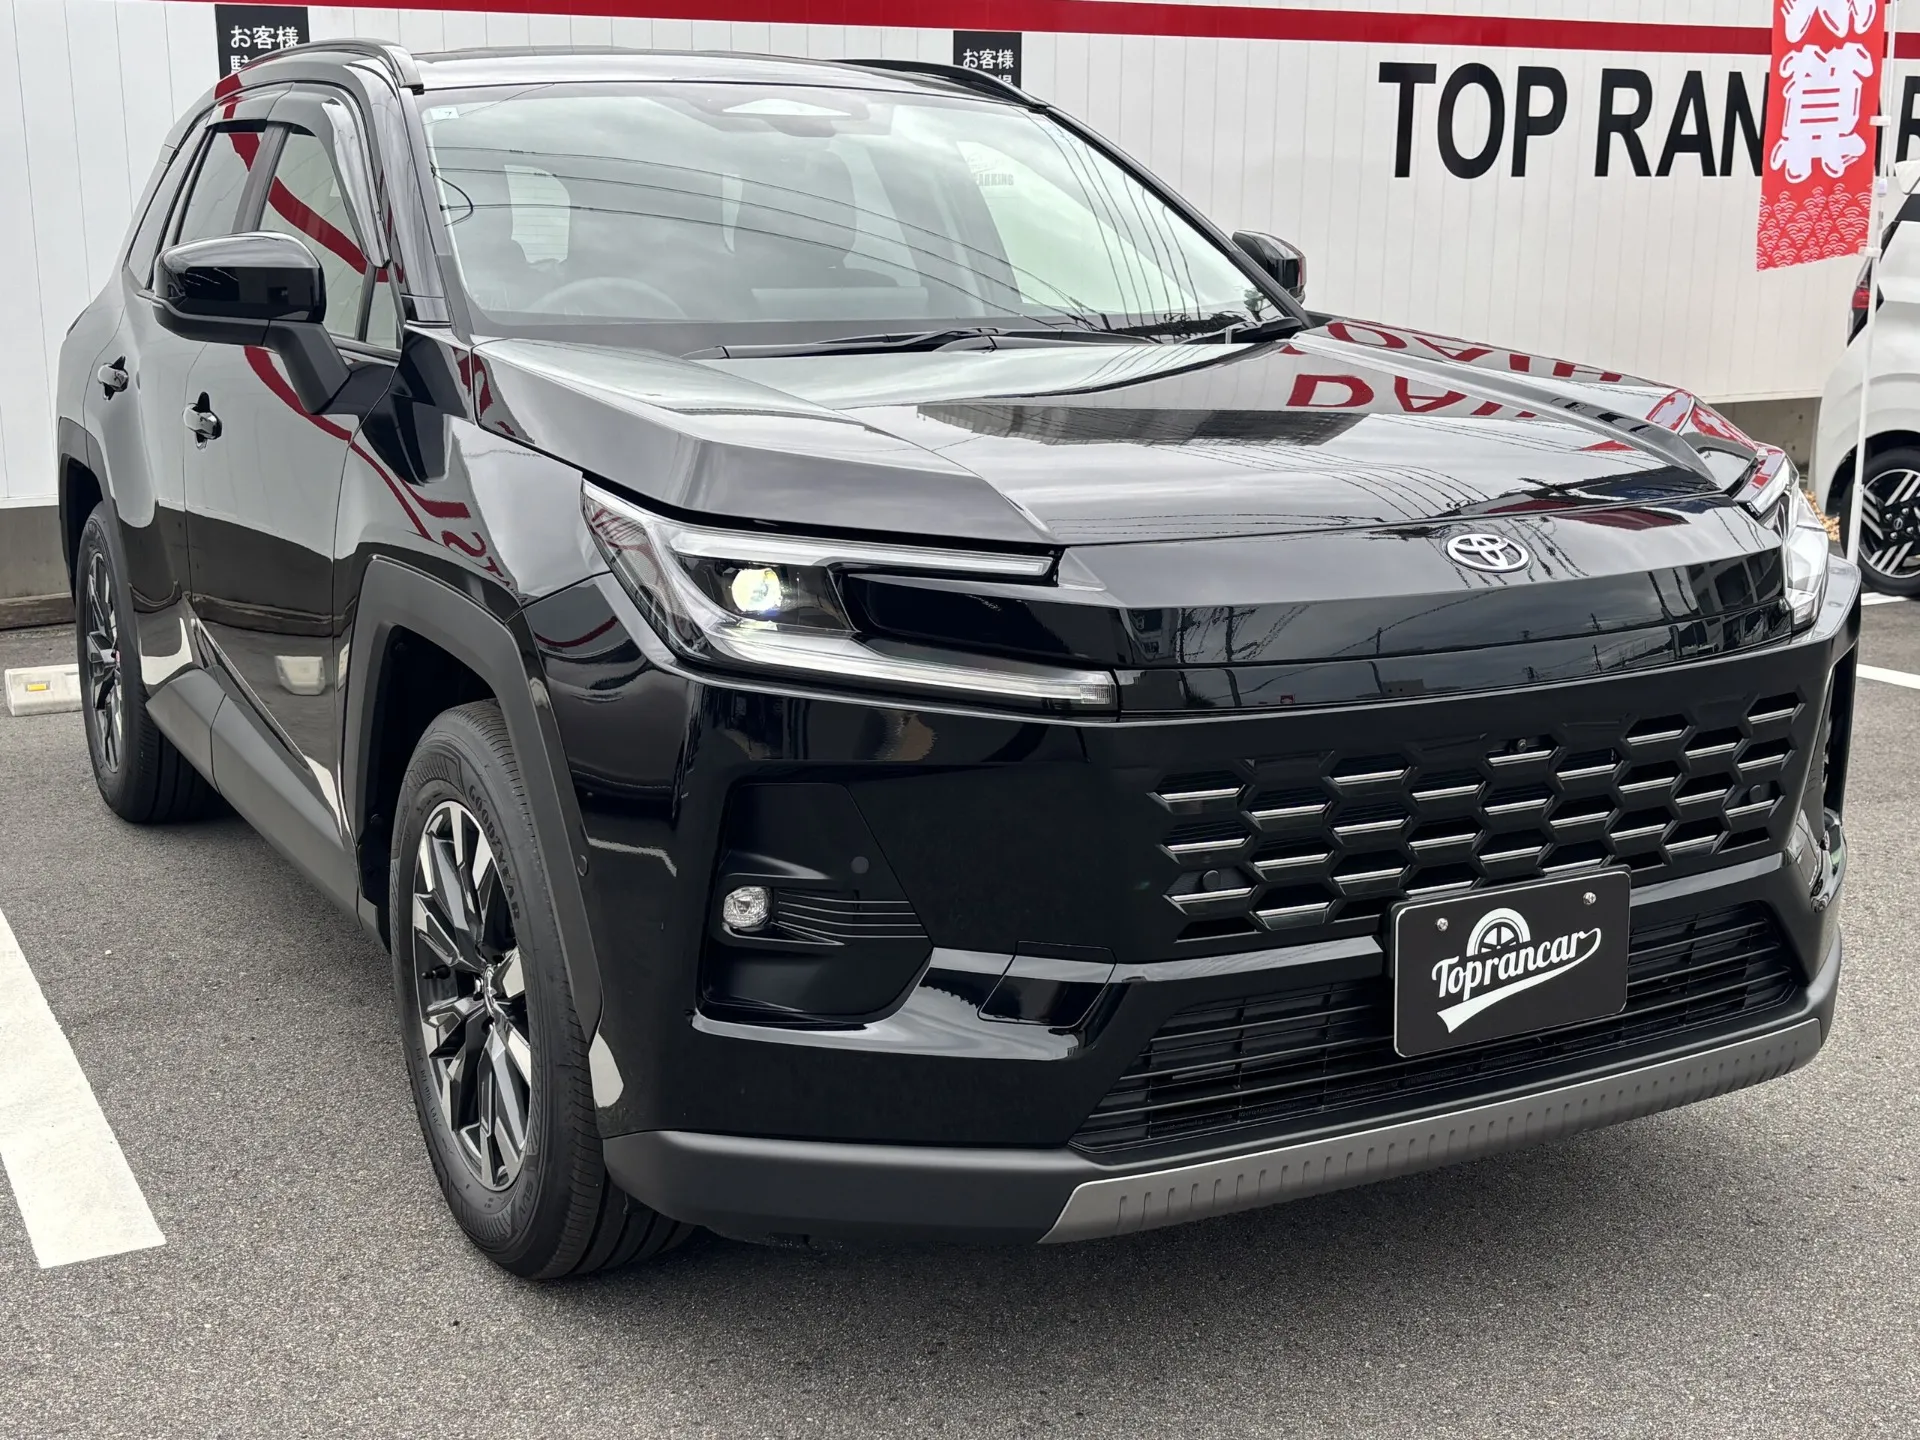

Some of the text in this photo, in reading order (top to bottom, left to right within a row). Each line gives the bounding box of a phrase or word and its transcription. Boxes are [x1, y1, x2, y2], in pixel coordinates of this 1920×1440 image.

[230, 25, 300, 49] お客様
[962, 48, 1014, 70] お客様
[1379, 62, 1568, 179] TOP
[1770, 0, 1874, 184] 算
[468, 784, 520, 919] GOODYEAR
[1431, 928, 1600, 1002] Toprancar
